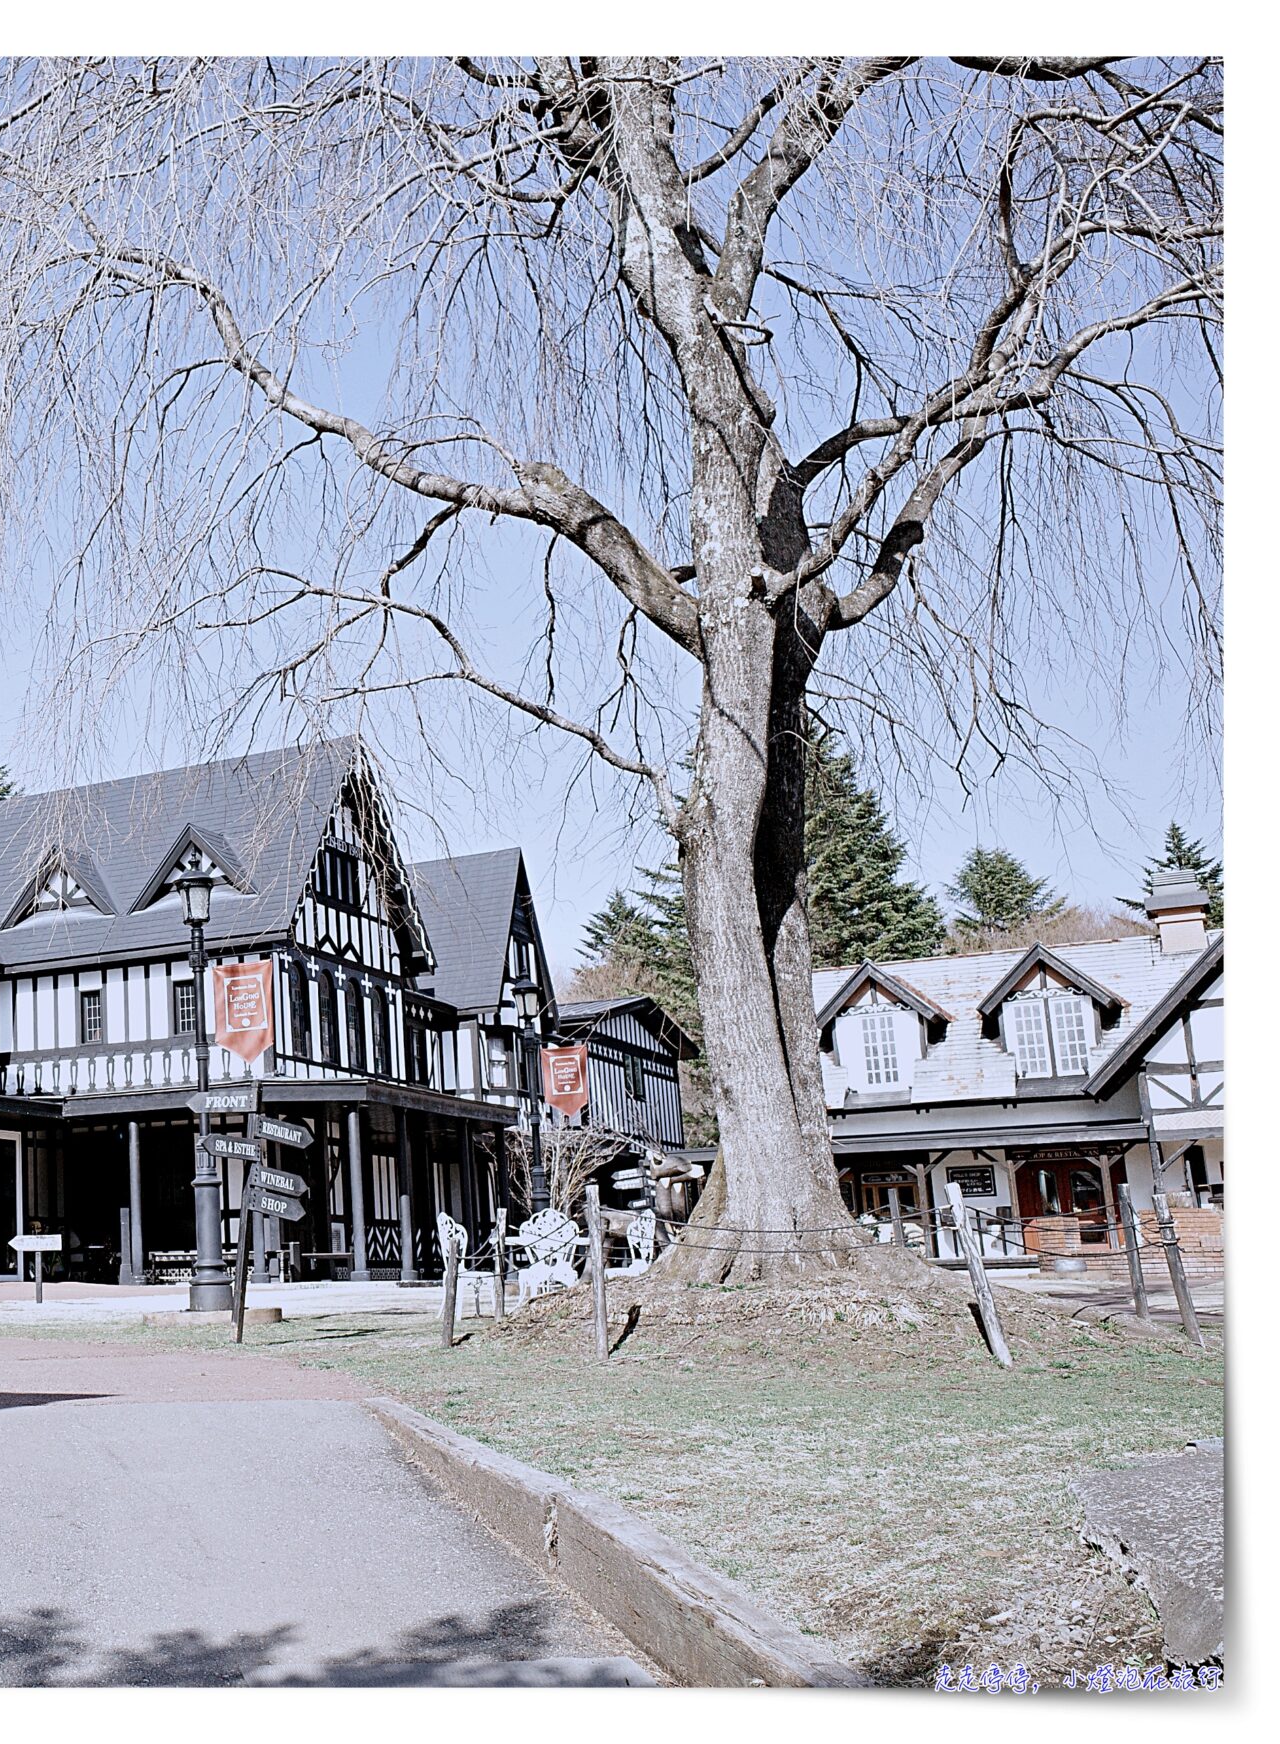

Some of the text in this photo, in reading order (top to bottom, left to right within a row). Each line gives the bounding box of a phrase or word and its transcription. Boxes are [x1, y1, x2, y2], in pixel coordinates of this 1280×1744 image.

[205, 1095, 248, 1109] FRONT
[261, 1122, 302, 1144] RESTAURANT
[215, 1139, 256, 1157] SPA & ESTHE
[260, 1171, 295, 1191] WINEBAL
[261, 1197, 288, 1214] SHOP
